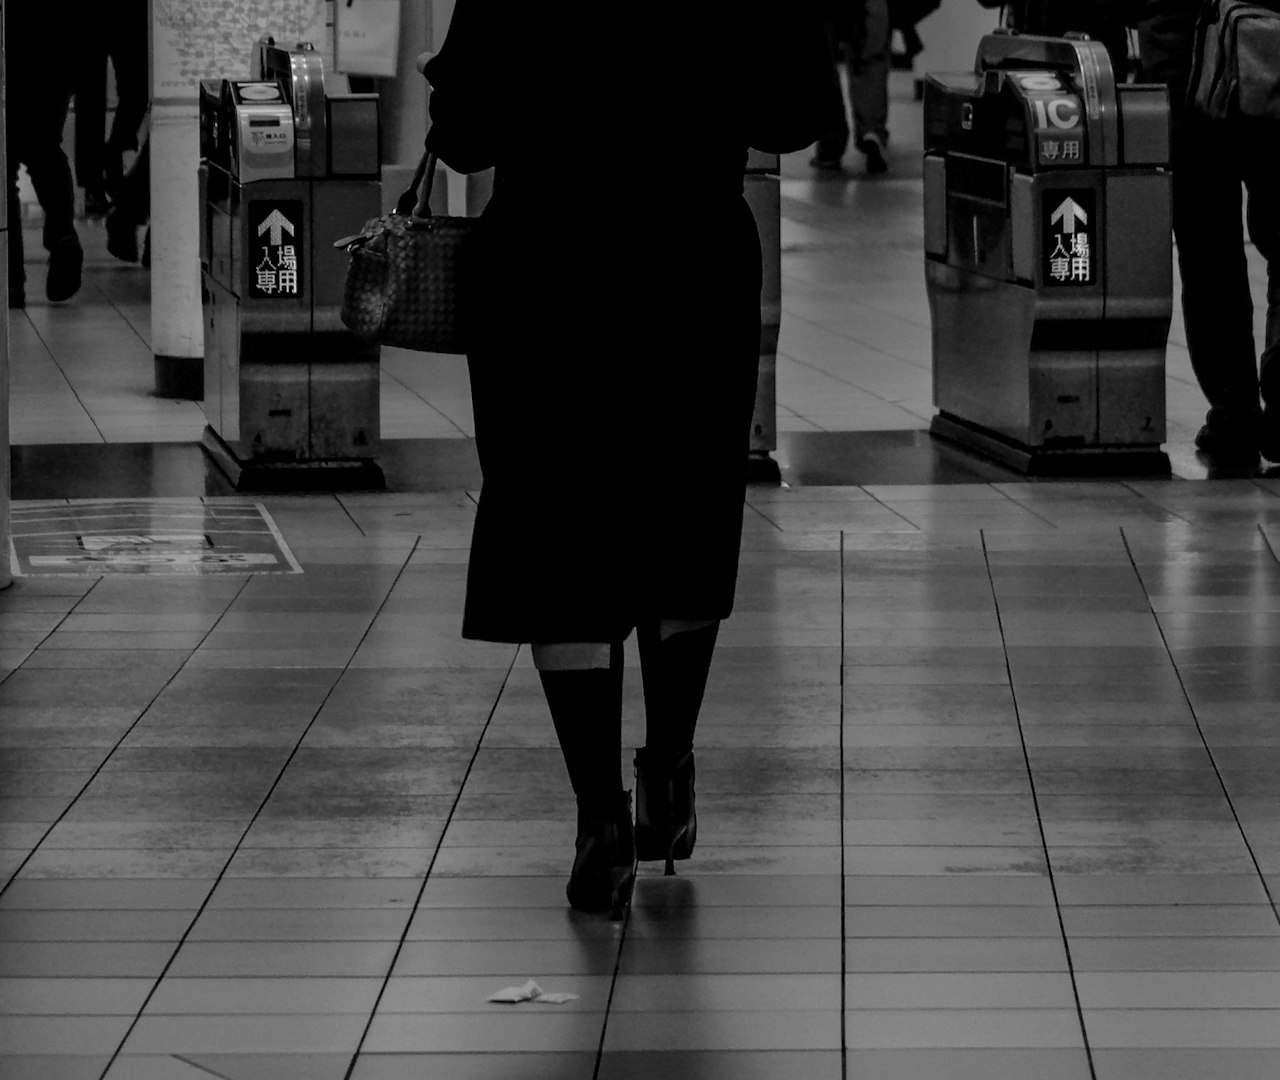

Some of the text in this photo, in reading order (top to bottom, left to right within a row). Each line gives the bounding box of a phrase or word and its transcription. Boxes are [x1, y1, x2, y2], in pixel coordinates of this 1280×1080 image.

[1034, 98, 1080, 130] IC
[1041, 140, 1080, 160] 専用
[256, 245, 298, 270] 入場
[1049, 232, 1090, 258] 入場
[1049, 257, 1090, 282] 専用
[255, 270, 298, 295] 専用
